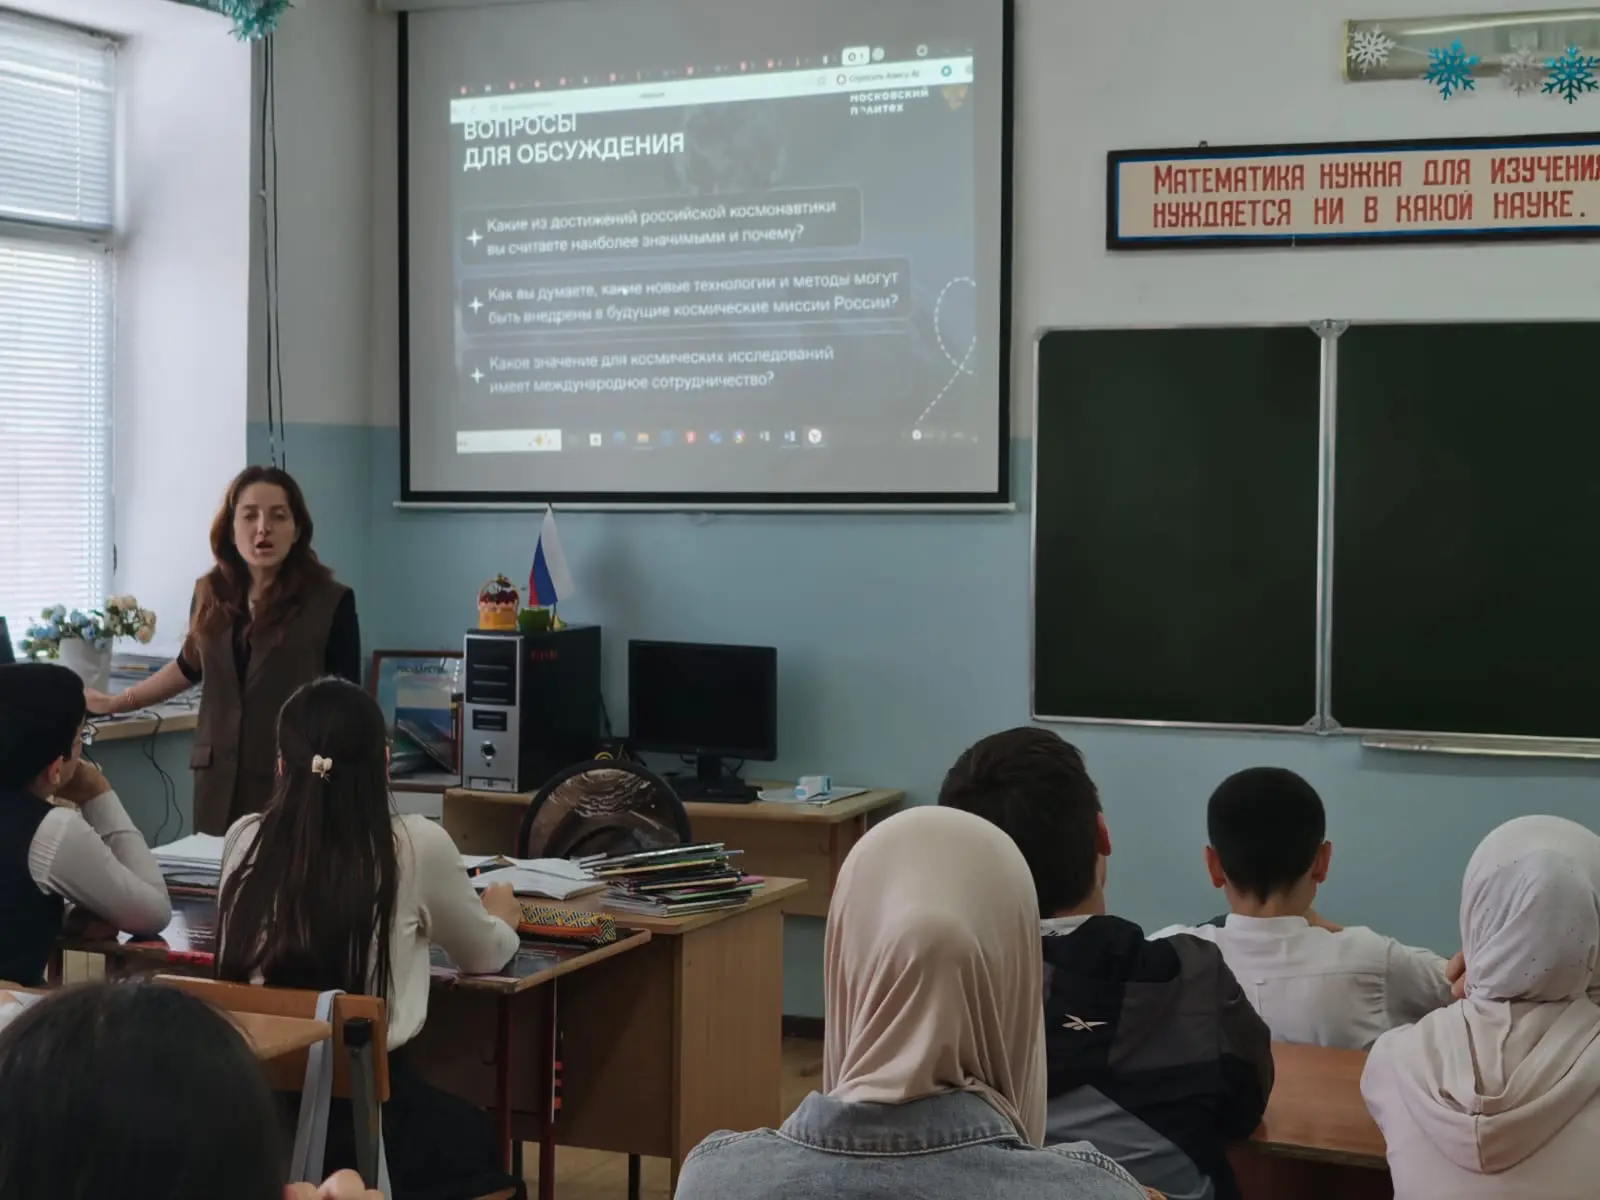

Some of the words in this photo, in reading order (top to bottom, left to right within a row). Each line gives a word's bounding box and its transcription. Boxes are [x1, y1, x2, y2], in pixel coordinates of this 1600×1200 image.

[464, 112, 577, 141] ВОПРОСЫ
[463, 146, 511, 172] ДЛЯ
[517, 132, 685, 164] ОБСУЖДЕНИЯ
[1320, 160, 1402, 190] НУЖНА
[1423, 158, 1471, 186] ДЛЯ
[487, 214, 528, 232] Какие
[531, 215, 548, 230] из
[550, 209, 637, 231] достижений
[641, 203, 726, 227] российской
[730, 199, 836, 218] космонавтики
[1153, 198, 1291, 228] НУЖДАЕТСЯ
[1314, 197, 1344, 225] НИ
[1364, 195, 1379, 223] В
[1396, 189, 1473, 223] КАКОЙ
[487, 242, 505, 256] вы
[509, 237, 567, 255] считаете
[571, 231, 639, 252] наиболее
[642, 230, 726, 248] значимыми
[730, 229, 738, 243] и
[742, 223, 804, 245] почему?
[488, 287, 513, 302] Как
[517, 287, 535, 301] вы
[537, 284, 598, 303] думаете,
[602, 283, 642, 297] какие
[646, 280, 690, 295] новые
[694, 276, 776, 293] технологии
[780, 275, 789, 289] и
[793, 272, 849, 290] методы
[854, 270, 899, 288] могут
[488, 311, 520, 325] быть
[524, 308, 592, 327] внедрены
[595, 308, 603, 320] в
[607, 303, 670, 322] будущие
[674, 301, 769, 317] космические
[773, 298, 830, 313] миссии
[834, 293, 899, 311] России?
[490, 355, 529, 372] Какое
[533, 354, 598, 370] значение
[602, 353, 627, 369] для
[631, 350, 724, 366] космических
[728, 344, 834, 363] исследований
[490, 380, 530, 394] имеет
[534, 375, 648, 394] международное
[652, 370, 774, 391] сотрудничество?
